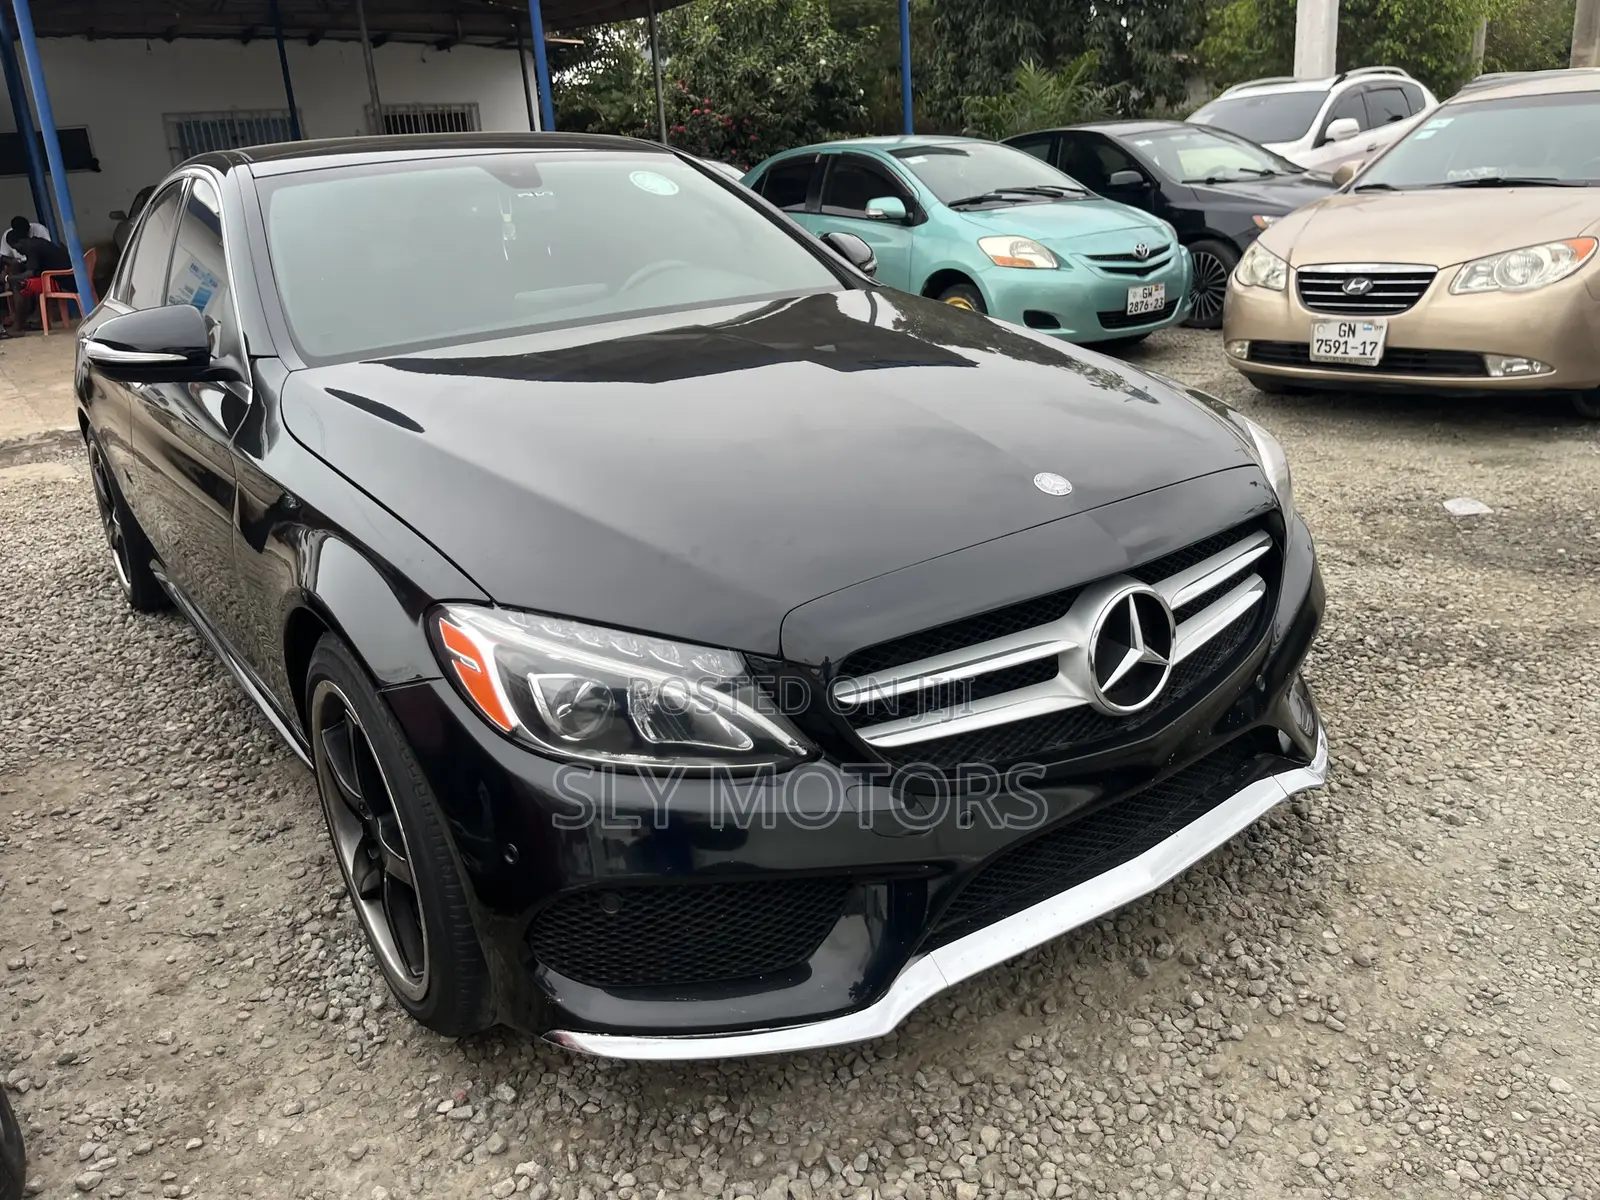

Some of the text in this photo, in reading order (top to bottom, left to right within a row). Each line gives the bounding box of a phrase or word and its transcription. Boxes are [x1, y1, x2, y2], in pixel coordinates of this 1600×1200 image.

[1142, 287, 1153, 299] GW
[1128, 297, 1164, 314] 2876-23
[1338, 322, 1357, 338] GN
[1316, 338, 1378, 356] 7591-17
